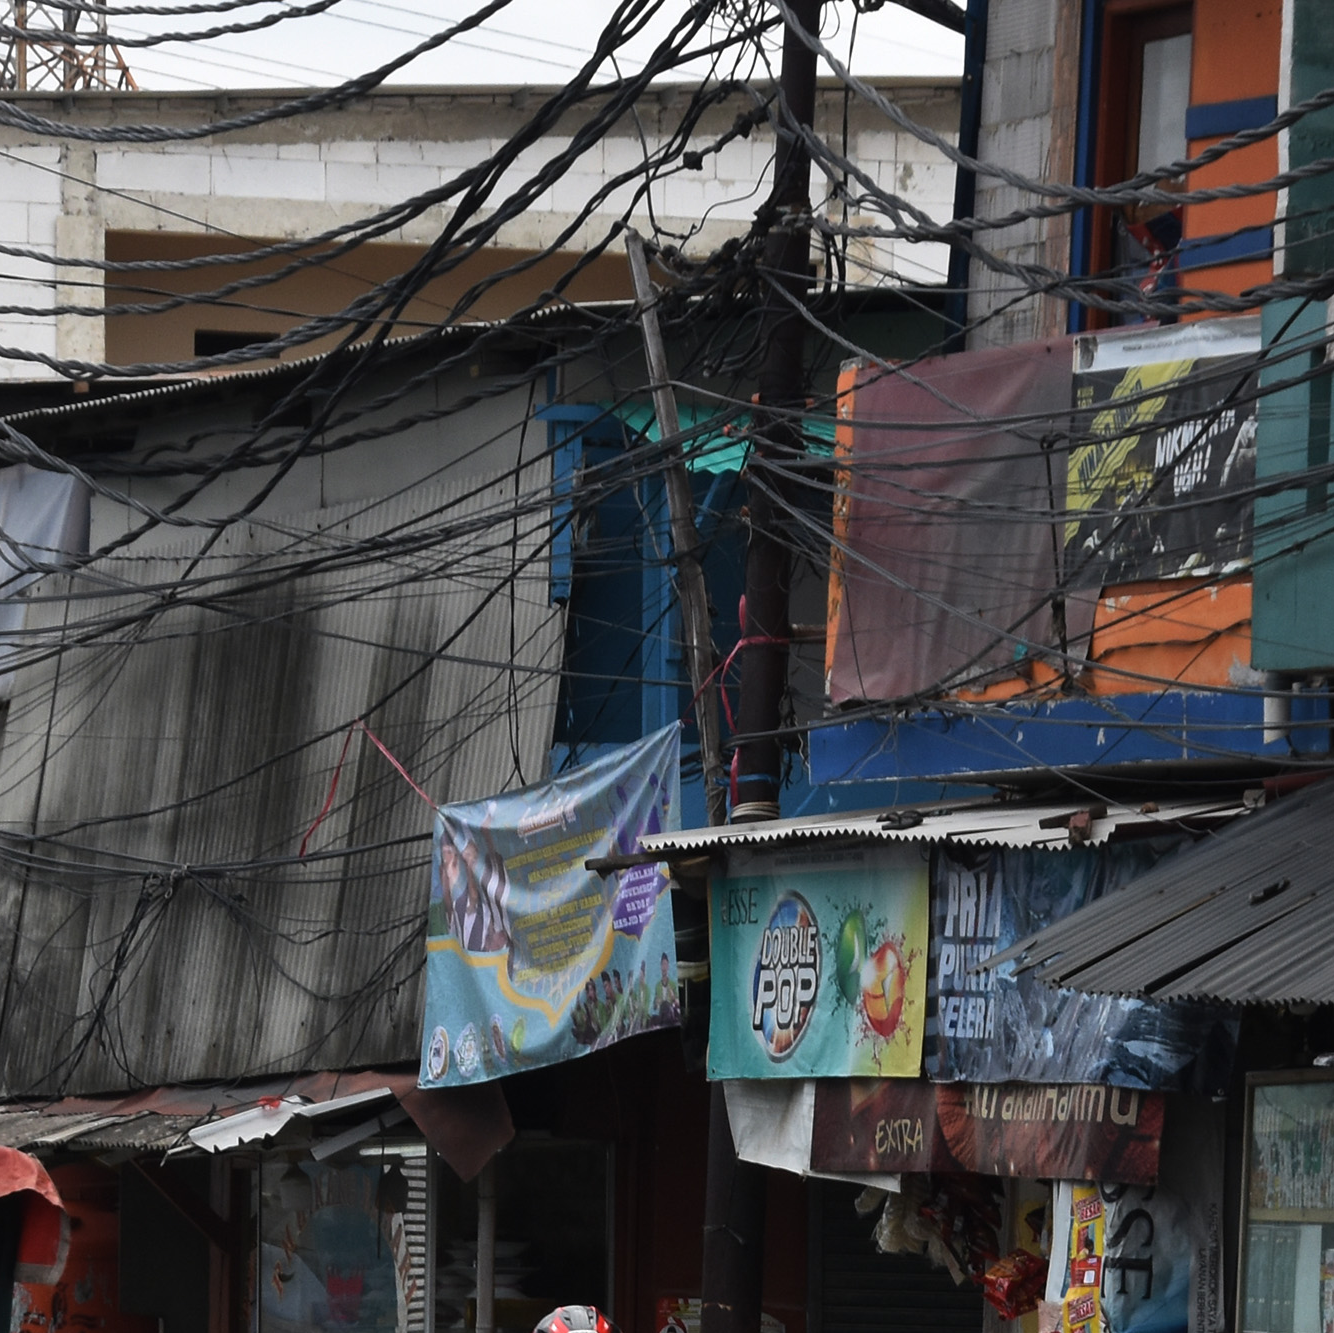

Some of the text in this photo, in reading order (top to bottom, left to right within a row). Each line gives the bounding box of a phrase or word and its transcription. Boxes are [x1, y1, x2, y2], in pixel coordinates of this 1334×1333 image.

[728, 888, 758, 926] ESSE
[944, 871, 1002, 937] PRIA
[761, 924, 817, 966] DOUBLE
[938, 943, 998, 990] PUNYA
[753, 966, 817, 1031] POP
[875, 1118, 924, 1156] EXTRA
